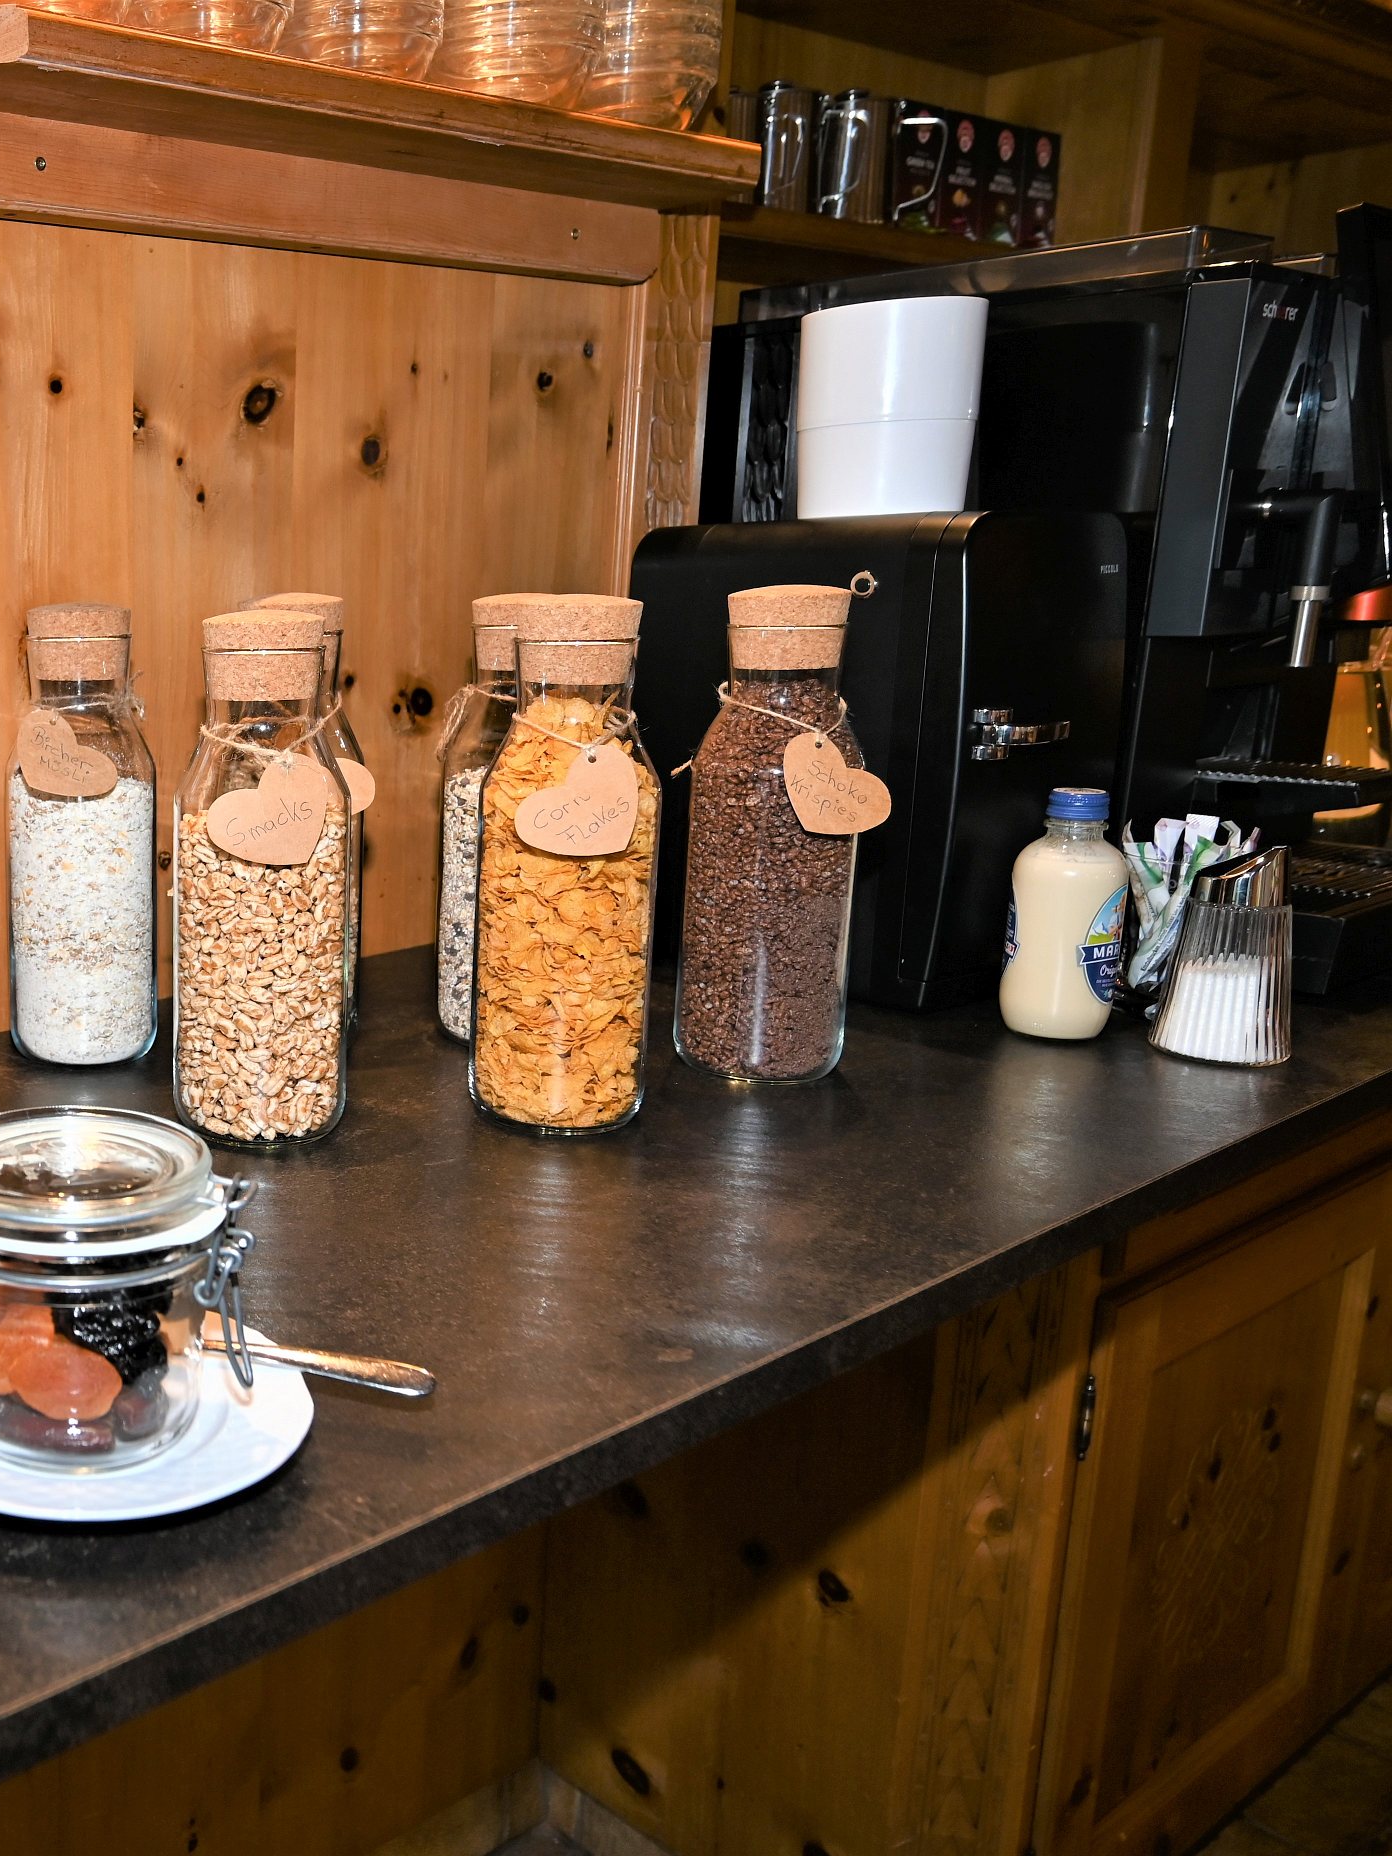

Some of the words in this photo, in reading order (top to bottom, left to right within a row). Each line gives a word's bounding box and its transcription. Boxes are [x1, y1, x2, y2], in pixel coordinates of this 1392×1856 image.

[1262, 299, 1299, 321] schrer
[31, 726, 94, 770] Bircher
[790, 774, 857, 823] Krispies
[808, 760, 868, 804] Schoko
[226, 798, 313, 846] Smacks
[533, 795, 591, 829] Corn
[1093, 944, 1120, 959] MAR
